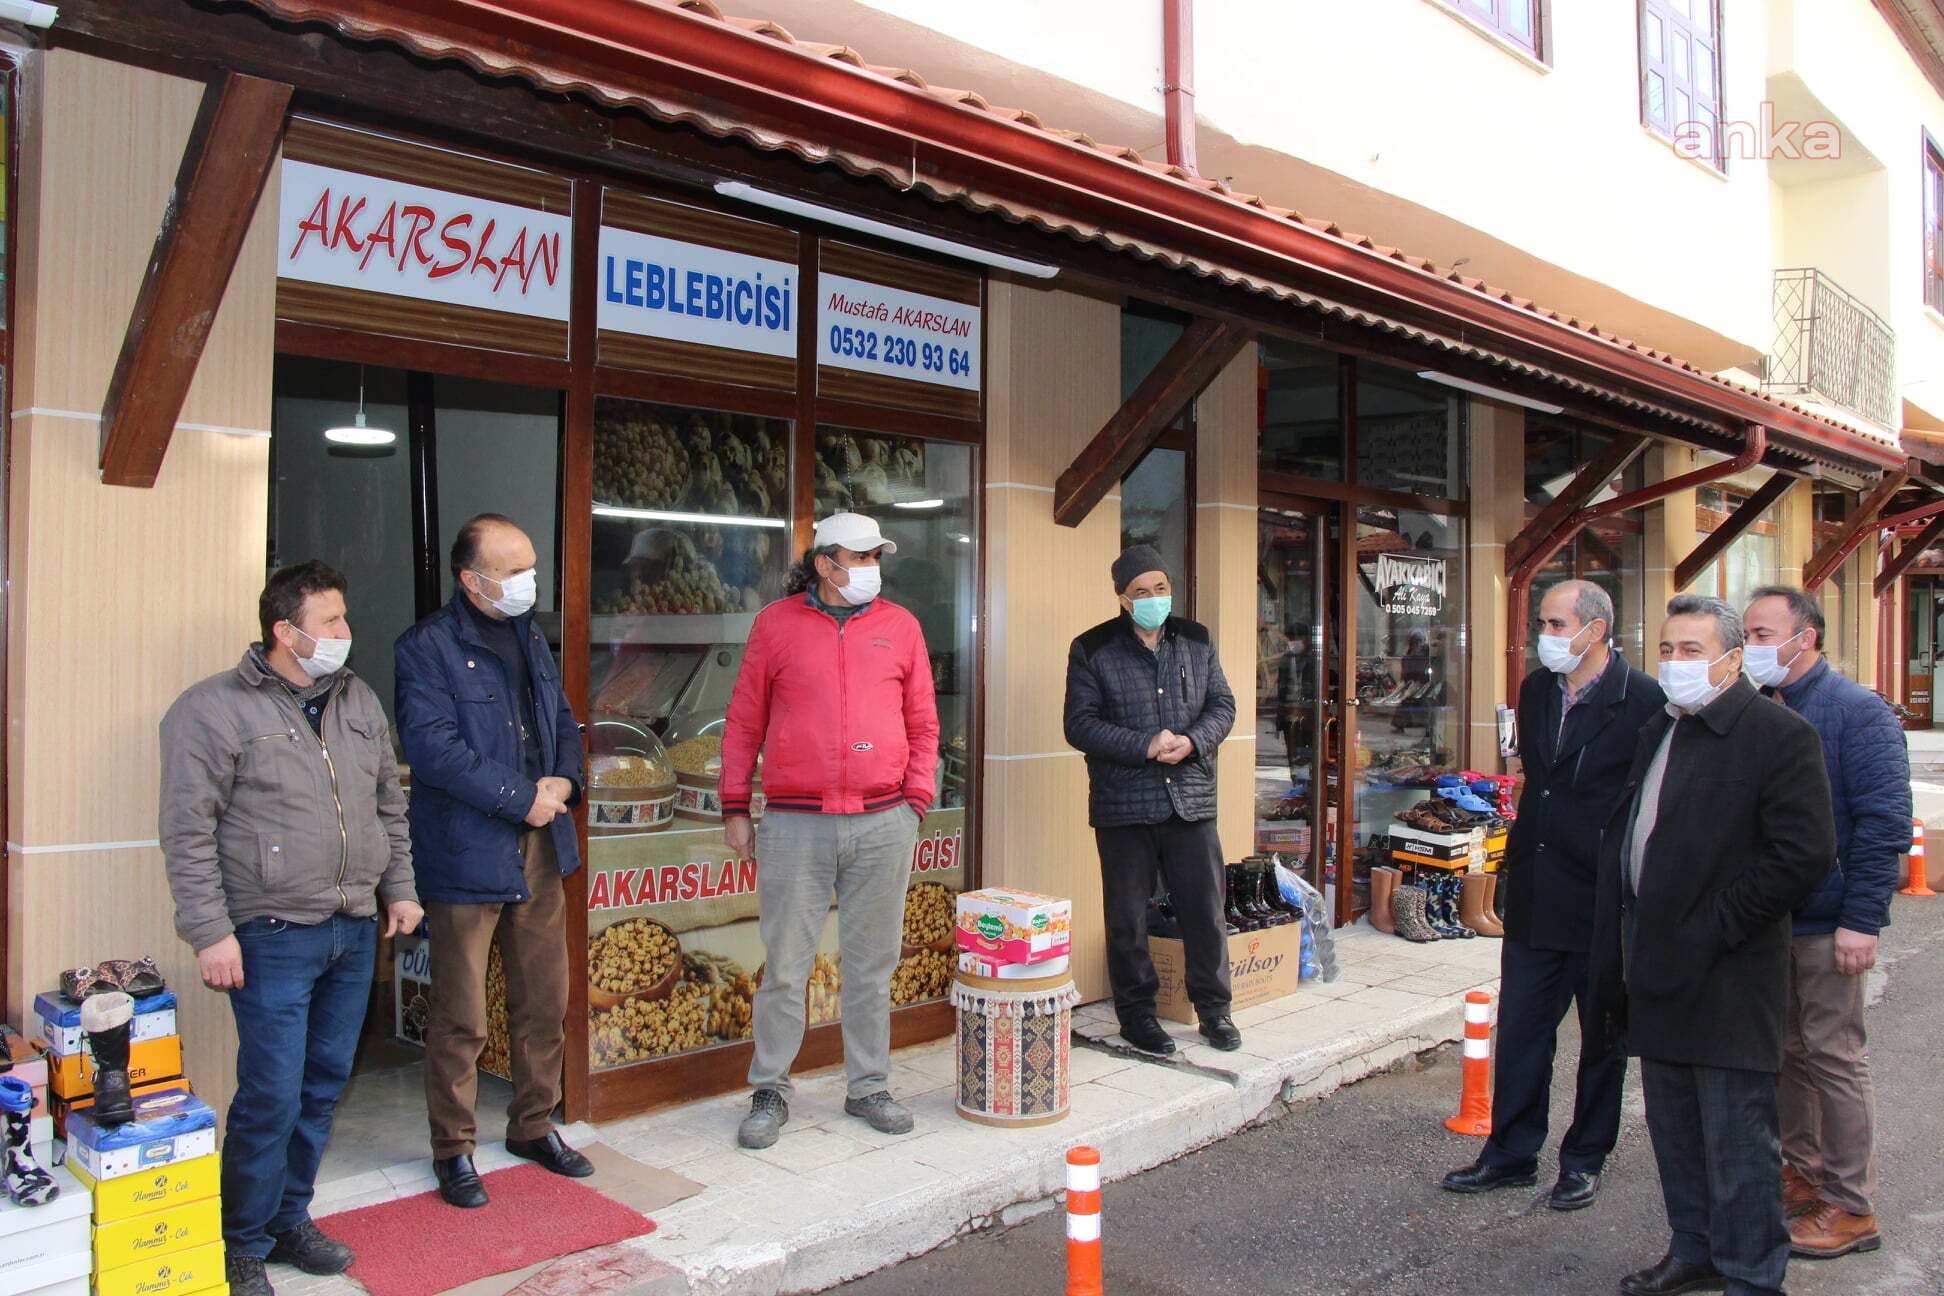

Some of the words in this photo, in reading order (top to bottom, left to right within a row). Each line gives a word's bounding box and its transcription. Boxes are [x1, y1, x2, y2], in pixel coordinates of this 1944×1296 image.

[290, 187, 560, 294] AKARSLAN
[827, 292, 889, 322] Mustafa
[892, 306, 972, 338] AKARSLAN
[830, 324, 878, 361] 0532
[884, 335, 917, 368] 230
[922, 342, 944, 373] 93
[949, 348, 970, 377] 64
[1385, 603, 1391, 613] 0
[1392, 604, 1405, 614] 505
[1406, 605, 1420, 615] 045
[1393, 585, 1407, 601] Ali
[1409, 587, 1430, 606] Kaya
[588, 859, 758, 910] AKARSLAN
[128, 1068, 147, 1079] ER
